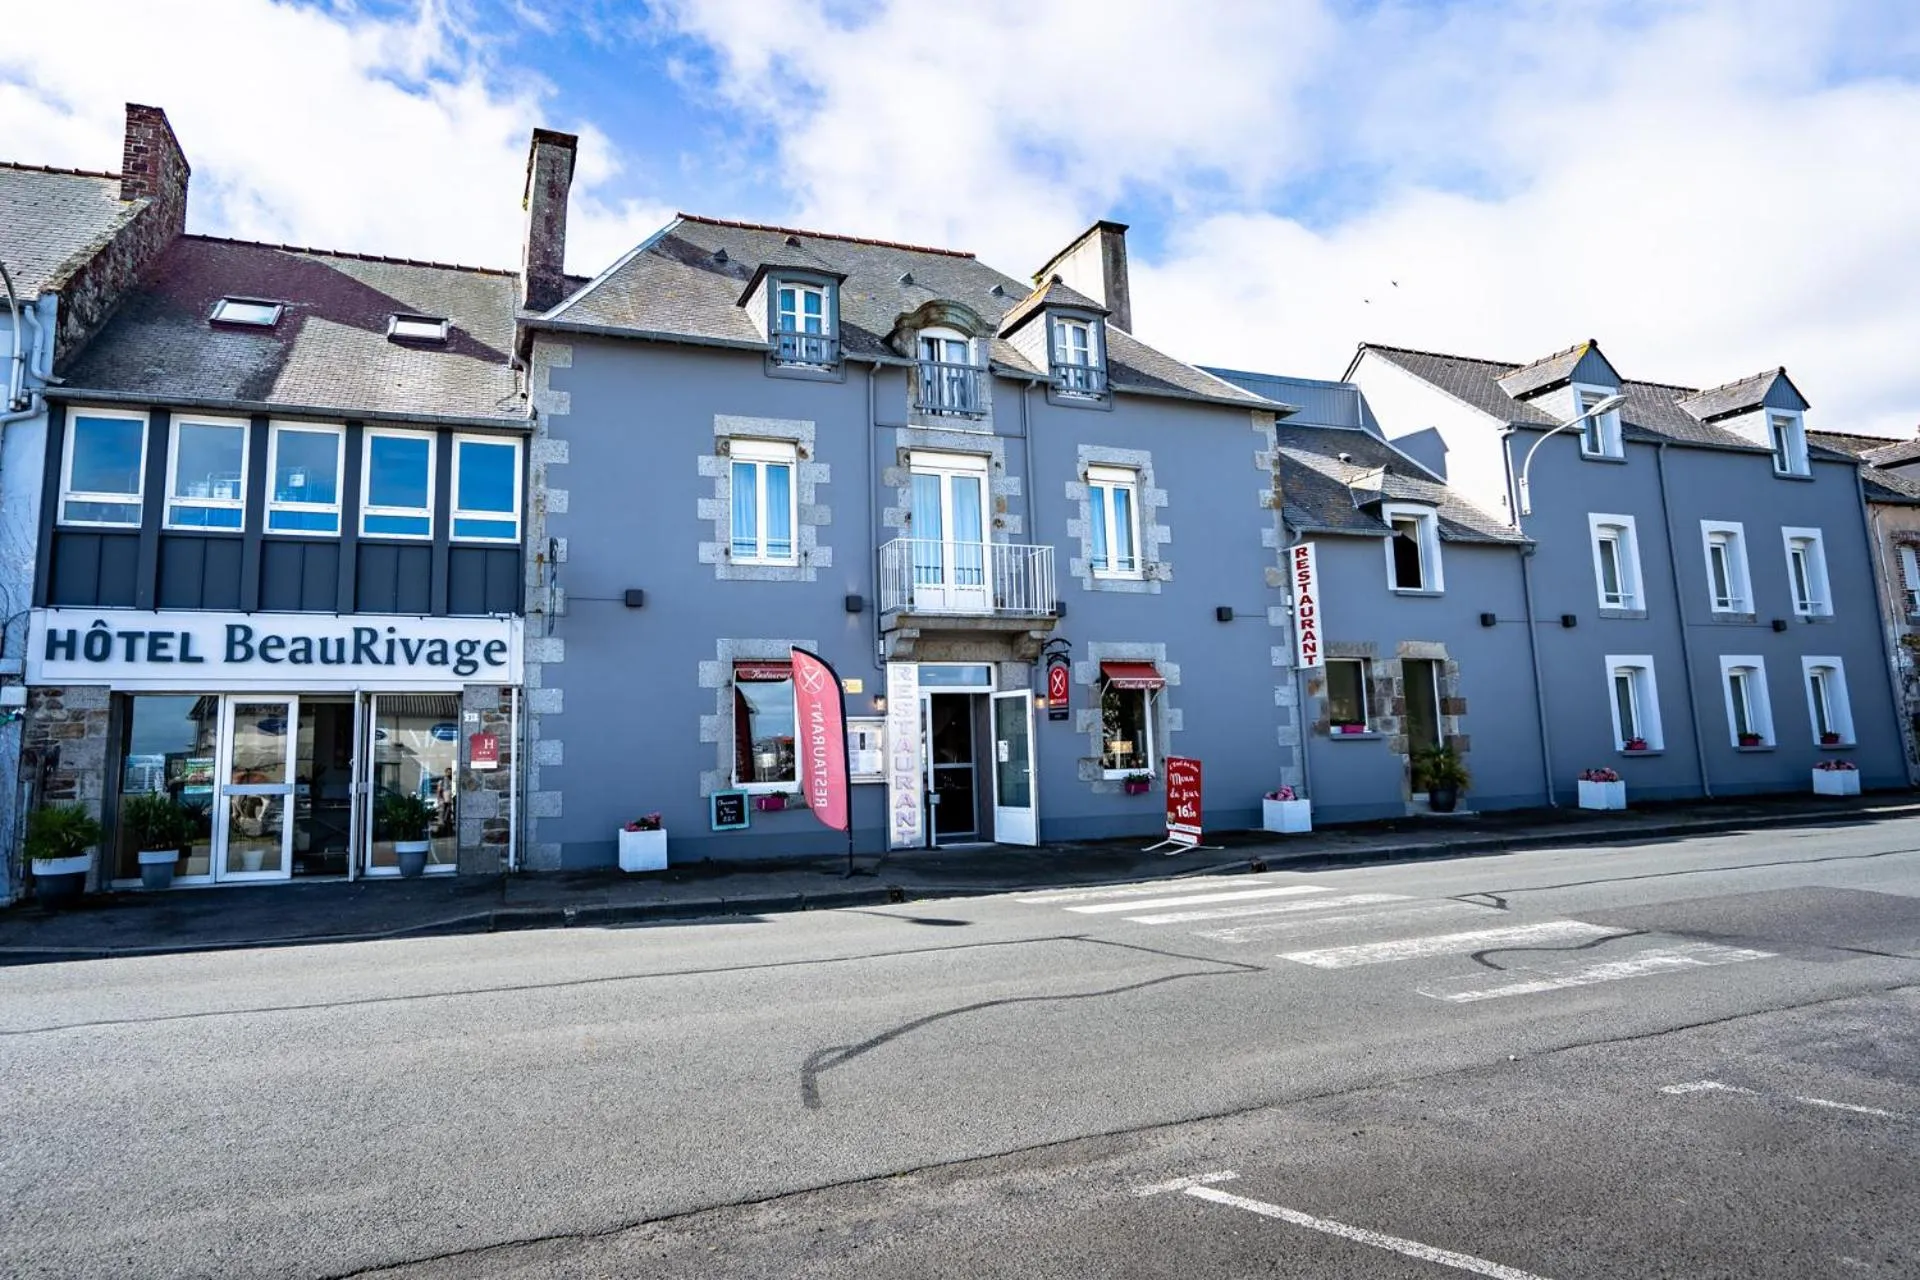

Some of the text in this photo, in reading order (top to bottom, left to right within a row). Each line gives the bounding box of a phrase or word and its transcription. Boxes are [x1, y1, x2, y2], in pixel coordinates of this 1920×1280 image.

[1295, 547, 1317, 665] RESTAURANT
[45, 619, 507, 676] HÔTEL BeauRivage
[484, 739, 494, 749] H
[893, 666, 916, 846] RESTAURANT
[1169, 773, 1194, 785] Menu
